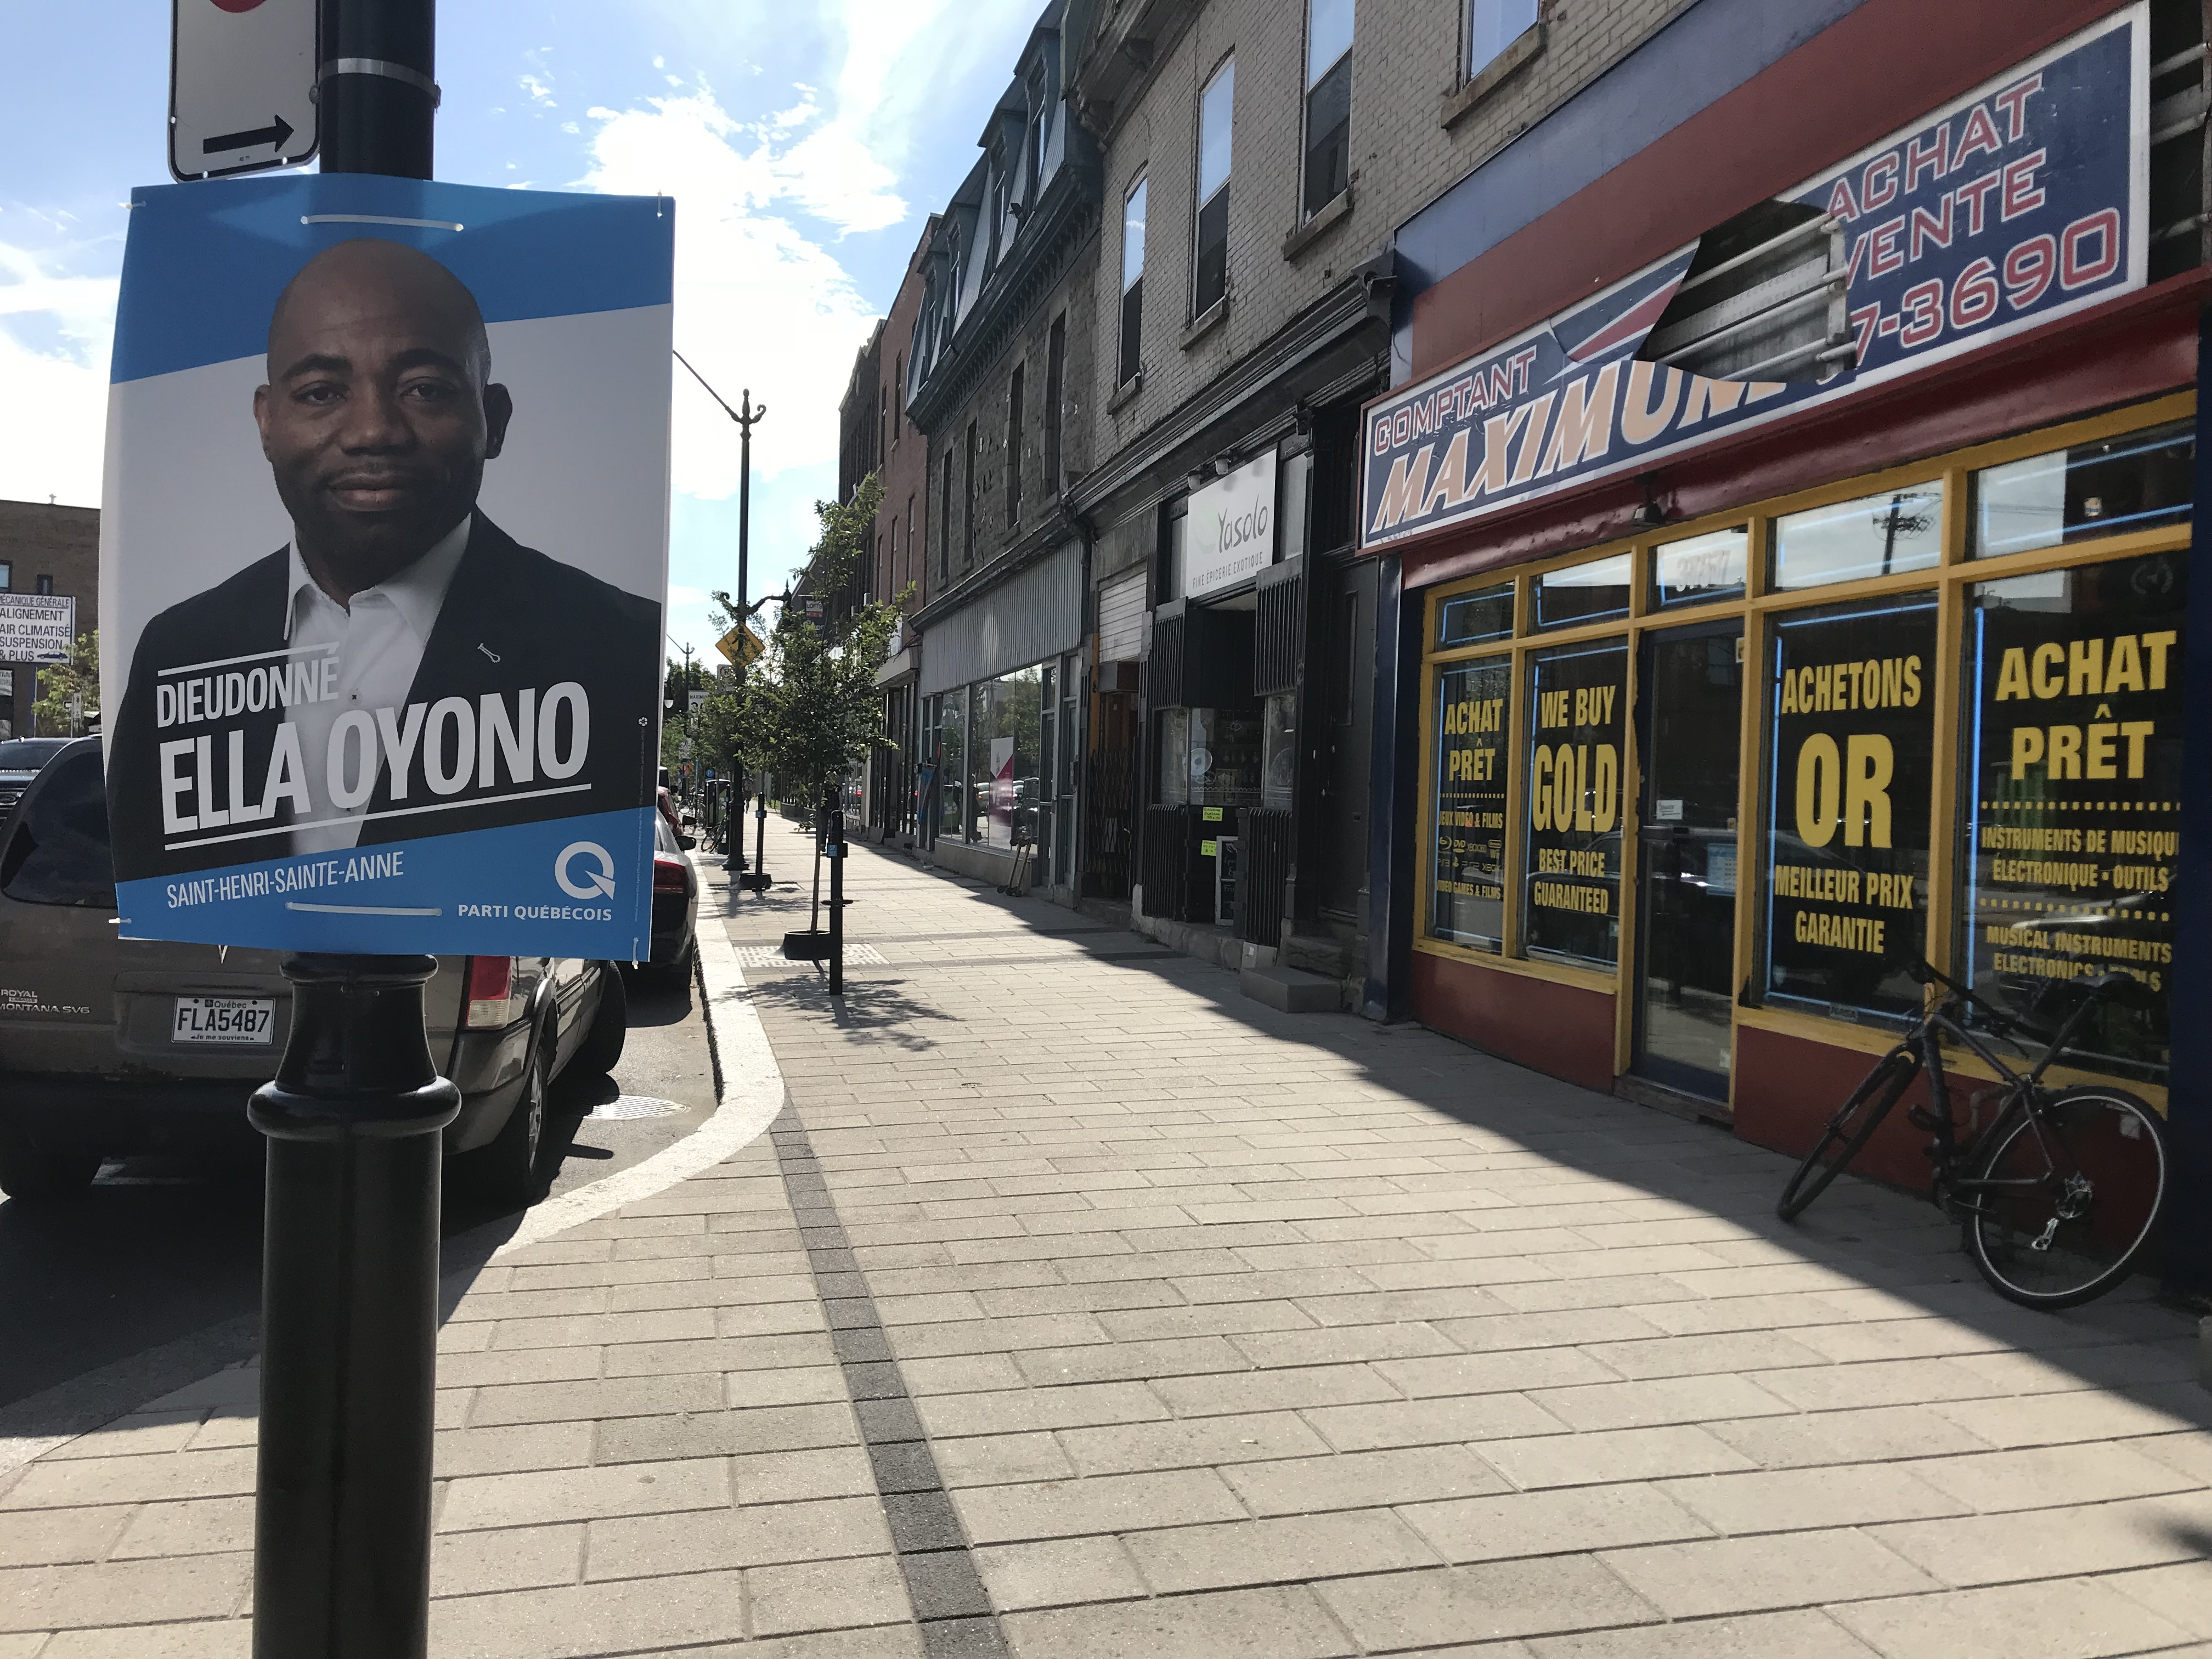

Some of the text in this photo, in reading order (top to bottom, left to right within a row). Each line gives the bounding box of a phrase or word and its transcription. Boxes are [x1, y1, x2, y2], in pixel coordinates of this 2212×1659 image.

[1827, 72, 2042, 223] ACHAT
[1846, 148, 2046, 290] VENTE
[1374, 345, 1536, 457] COMPTANT
[1217, 494, 1268, 554] Yasolo
[1193, 551, 1263, 589] FINE ÉPICERIE EXOTIQUE
[0, 607, 64, 621] ALIGNEMENT
[36, 596, 70, 607] GÉNÉRALE
[0, 623, 71, 637] AIR CLIMATISÉ
[0, 636, 63, 650] SUSPENSION
[9, 650, 35, 662] PLUS
[1995, 630, 2177, 702] ACHAT
[156, 646, 340, 729] DIEUDONNÉ
[1781, 655, 1922, 714] ACHETONS
[1444, 698, 1504, 735] ACHAT
[1541, 685, 1616, 728] WE BUY
[160, 681, 590, 834] ELLA OYONO
[2011, 703, 2155, 781] PRÊT
[1449, 742, 1496, 781] PRÊT
[1532, 743, 1617, 833] GOLD
[1795, 732, 1894, 849] OR
[1438, 811, 1454, 826] JEUX
[1475, 812, 1480, 827] &
[1482, 812, 1503, 829] FILMS
[1453, 839, 1466, 848] DVD
[1539, 848, 1605, 877] BEST PRICE
[1981, 826, 2180, 861] INSTRUMENTS DE MUSIQU
[167, 851, 404, 909] SAINT-HENRI-SAINTE-ANNE
[1436, 879, 1501, 900] VIDEO GAMES & FILMS
[1774, 865, 1860, 904] MEILLEUR
[1866, 872, 1914, 909] PRIX
[1993, 853, 2169, 892] ÉLECTRONIQUE OUTILS
[458, 904, 612, 921] PARTI QUÉBÉCOIS
[1534, 881, 1609, 915] GUARANTEED
[1795, 910, 1885, 954] GARANTIE
[1987, 925, 2173, 964] MUSICAL INSTRUMENTS
[1, 989, 38, 998] ROYAL
[63, 1006, 91, 1014] SV6
[214, 1001, 247, 1009] Québec
[177, 1007, 270, 1032] FLA5487
